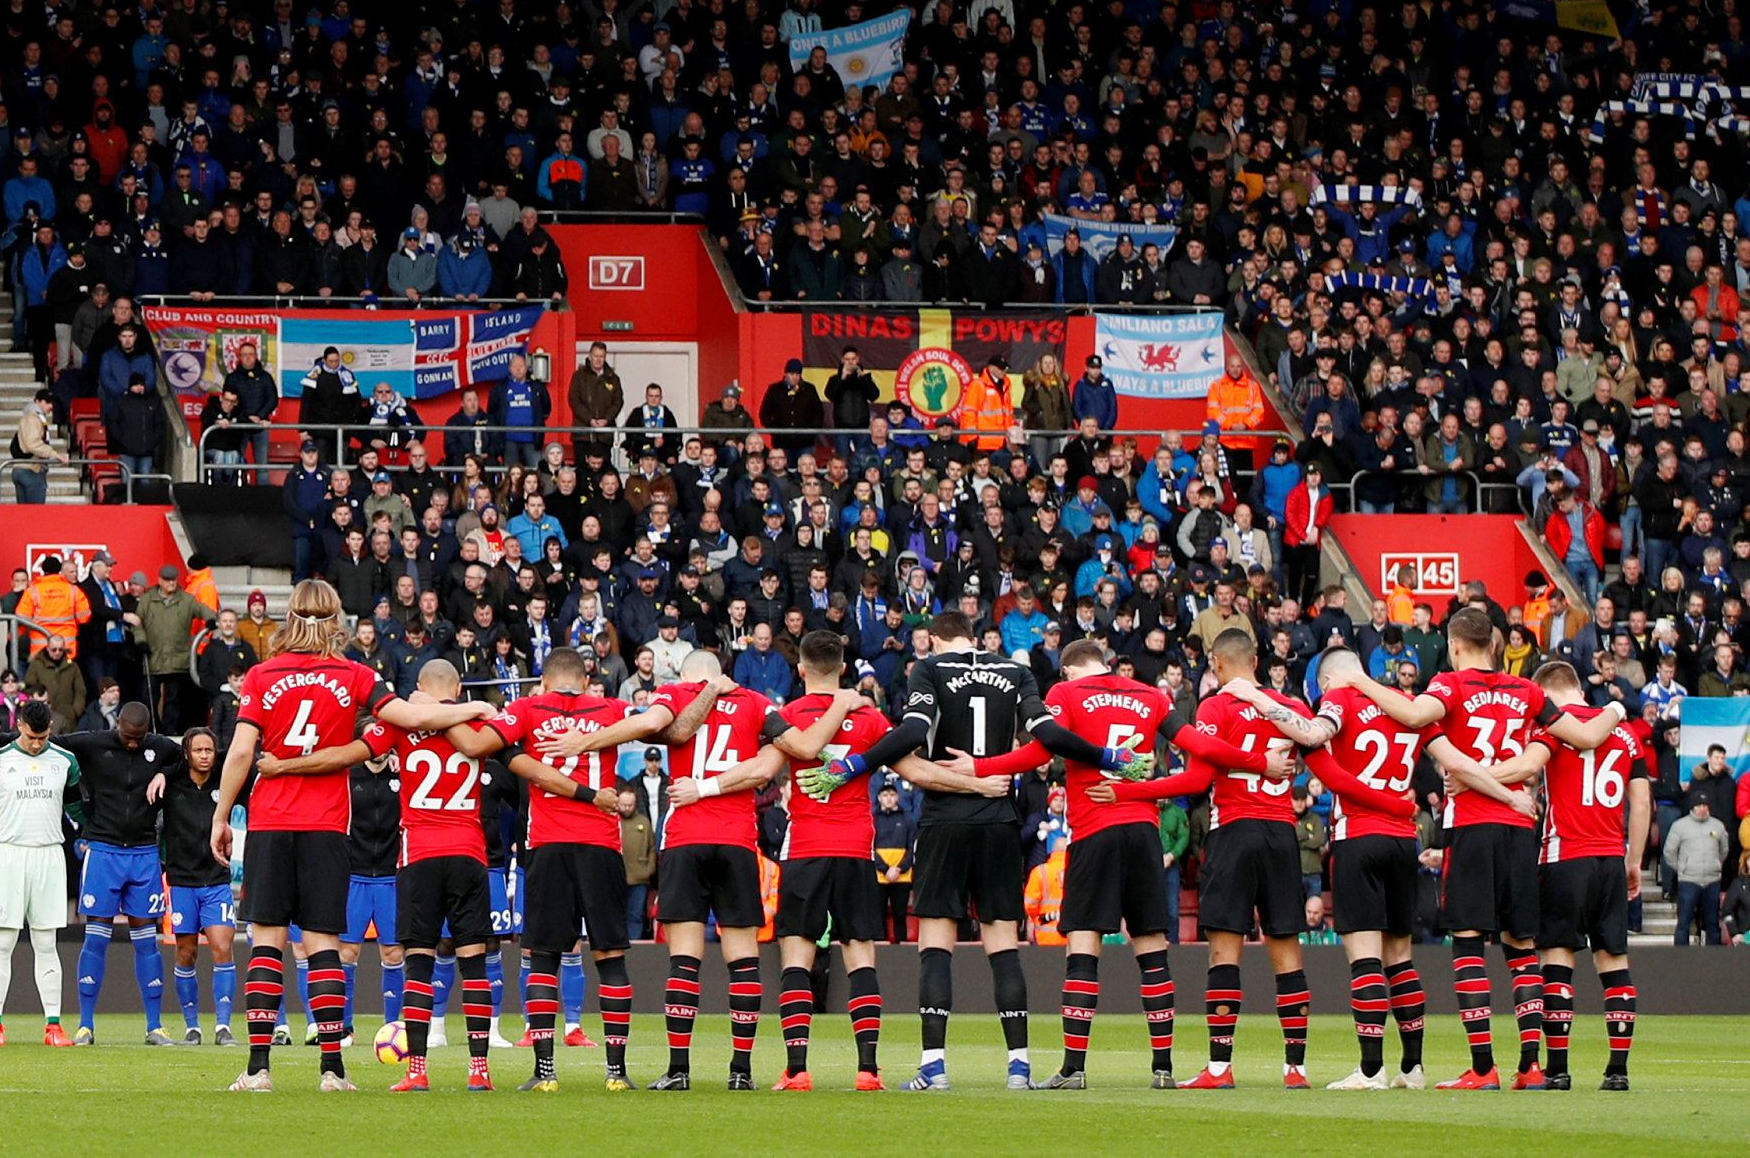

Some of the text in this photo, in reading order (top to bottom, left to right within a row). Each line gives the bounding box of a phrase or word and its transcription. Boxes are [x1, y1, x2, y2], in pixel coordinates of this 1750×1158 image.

[833, 34, 842, 48] A
[599, 261, 634, 284] D7
[146, 309, 278, 325] CLUB AND COUNTRY
[420, 313, 521, 336] BARRY ISLAND
[811, 312, 1066, 344] DINAS POWYS
[1178, 317, 1216, 331] SALA
[426, 353, 450, 364] CCFC
[925, 350, 950, 363] SOUL
[1111, 374, 1147, 390] WAYS
[1151, 376, 1159, 391] A
[1423, 562, 1454, 585] 45
[262, 672, 351, 710] VESTERGAARD
[947, 672, 1015, 693] McCARTHY
[1082, 693, 1151, 719] STEPHENS
[284, 699, 319, 756] 4
[969, 696, 986, 756] 1
[692, 724, 741, 781] 14
[1467, 716, 1525, 767] 35
[1354, 729, 1420, 791] 23
[24, 776, 44, 787] VISIT
[405, 749, 480, 810] 22
[1579, 749, 1624, 808] 16
[16, 788, 53, 801] MALAYSIA
[220, 902, 235, 922] 14
[490, 910, 512, 931] 29
